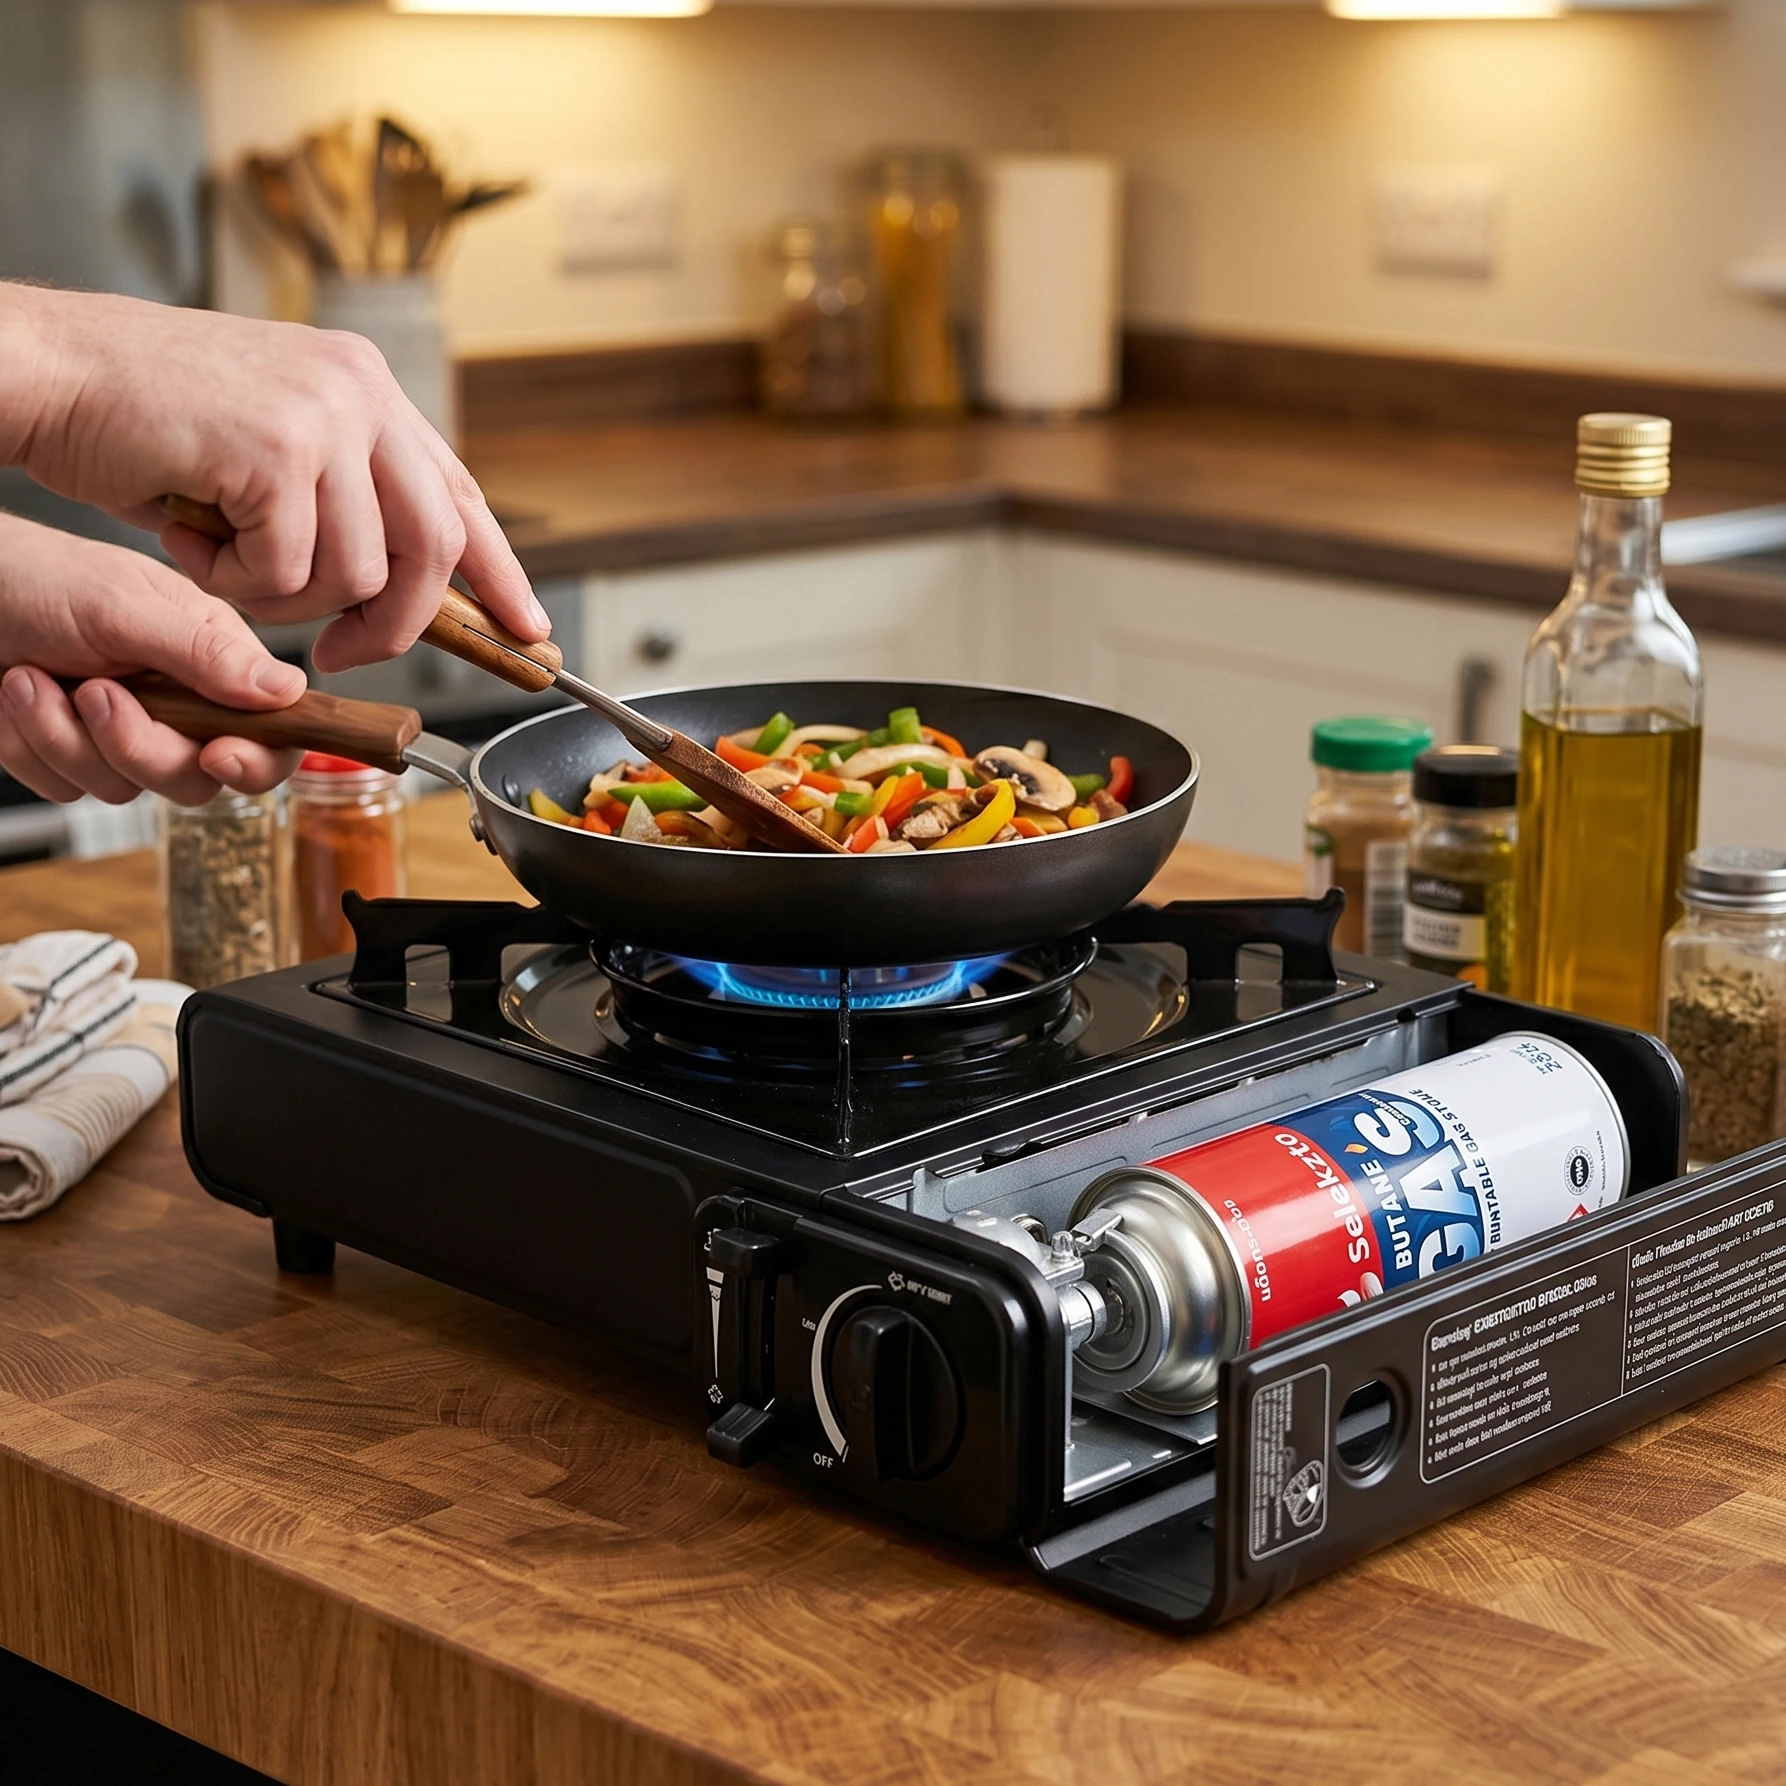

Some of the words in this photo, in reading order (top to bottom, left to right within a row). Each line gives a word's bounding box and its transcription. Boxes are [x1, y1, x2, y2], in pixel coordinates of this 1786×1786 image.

[1274, 1133, 1370, 1263] Selekzto
[1361, 1159, 1413, 1269] BUTANE
[813, 1452, 834, 1468] OFF
